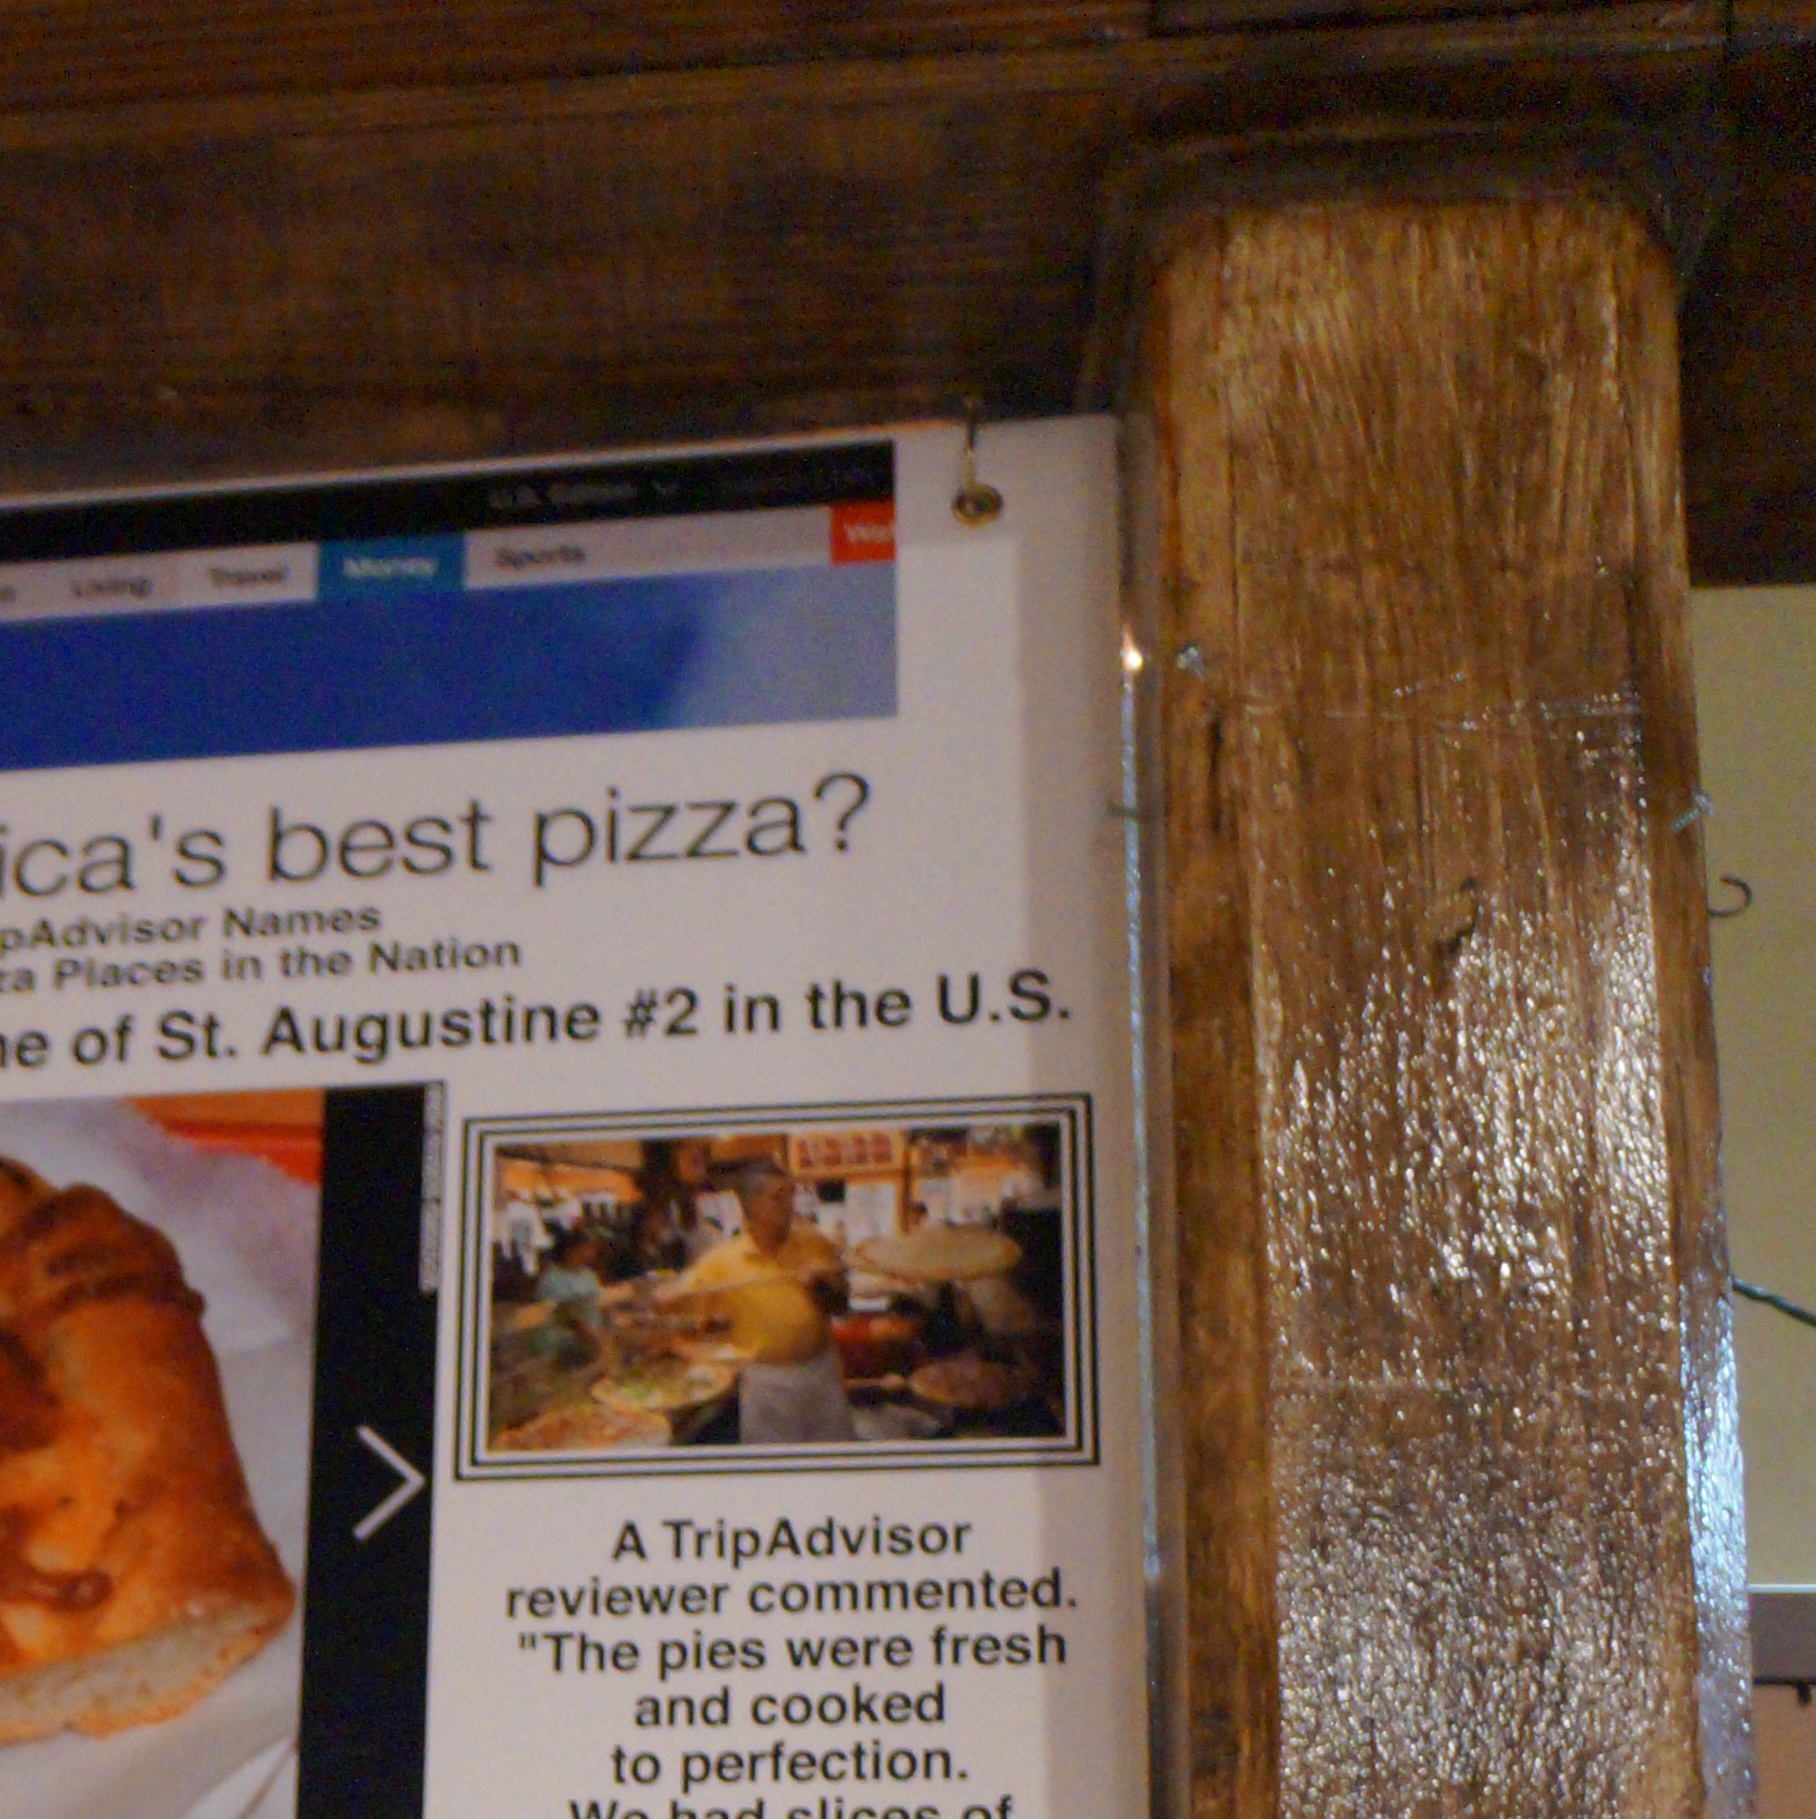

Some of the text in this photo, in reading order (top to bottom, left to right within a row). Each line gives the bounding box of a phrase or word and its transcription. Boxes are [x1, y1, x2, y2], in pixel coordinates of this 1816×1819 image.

[267, 799, 491, 884] best
[532, 771, 871, 889] pizza?
[222, 906, 381, 939] Names
[52, 957, 205, 991] Places
[220, 949, 263, 982] in
[278, 946, 353, 979] the
[368, 941, 521, 974] Nation
[70, 1014, 133, 1067] of
[156, 1009, 236, 1062] St.
[261, 995, 601, 1066] Augustine
[623, 986, 699, 1038] #2
[724, 984, 780, 1034] in
[806, 980, 912, 1031] the
[937, 967, 1072, 1026] U.S.
[611, 1515, 972, 1570] A TripAdvisor
[506, 1564, 1080, 1620] reviewer commented.
[519, 1623, 1068, 1683] "The pies were fresh
[634, 1681, 945, 1728] and cooked
[611, 1739, 968, 1796] to perfection.
